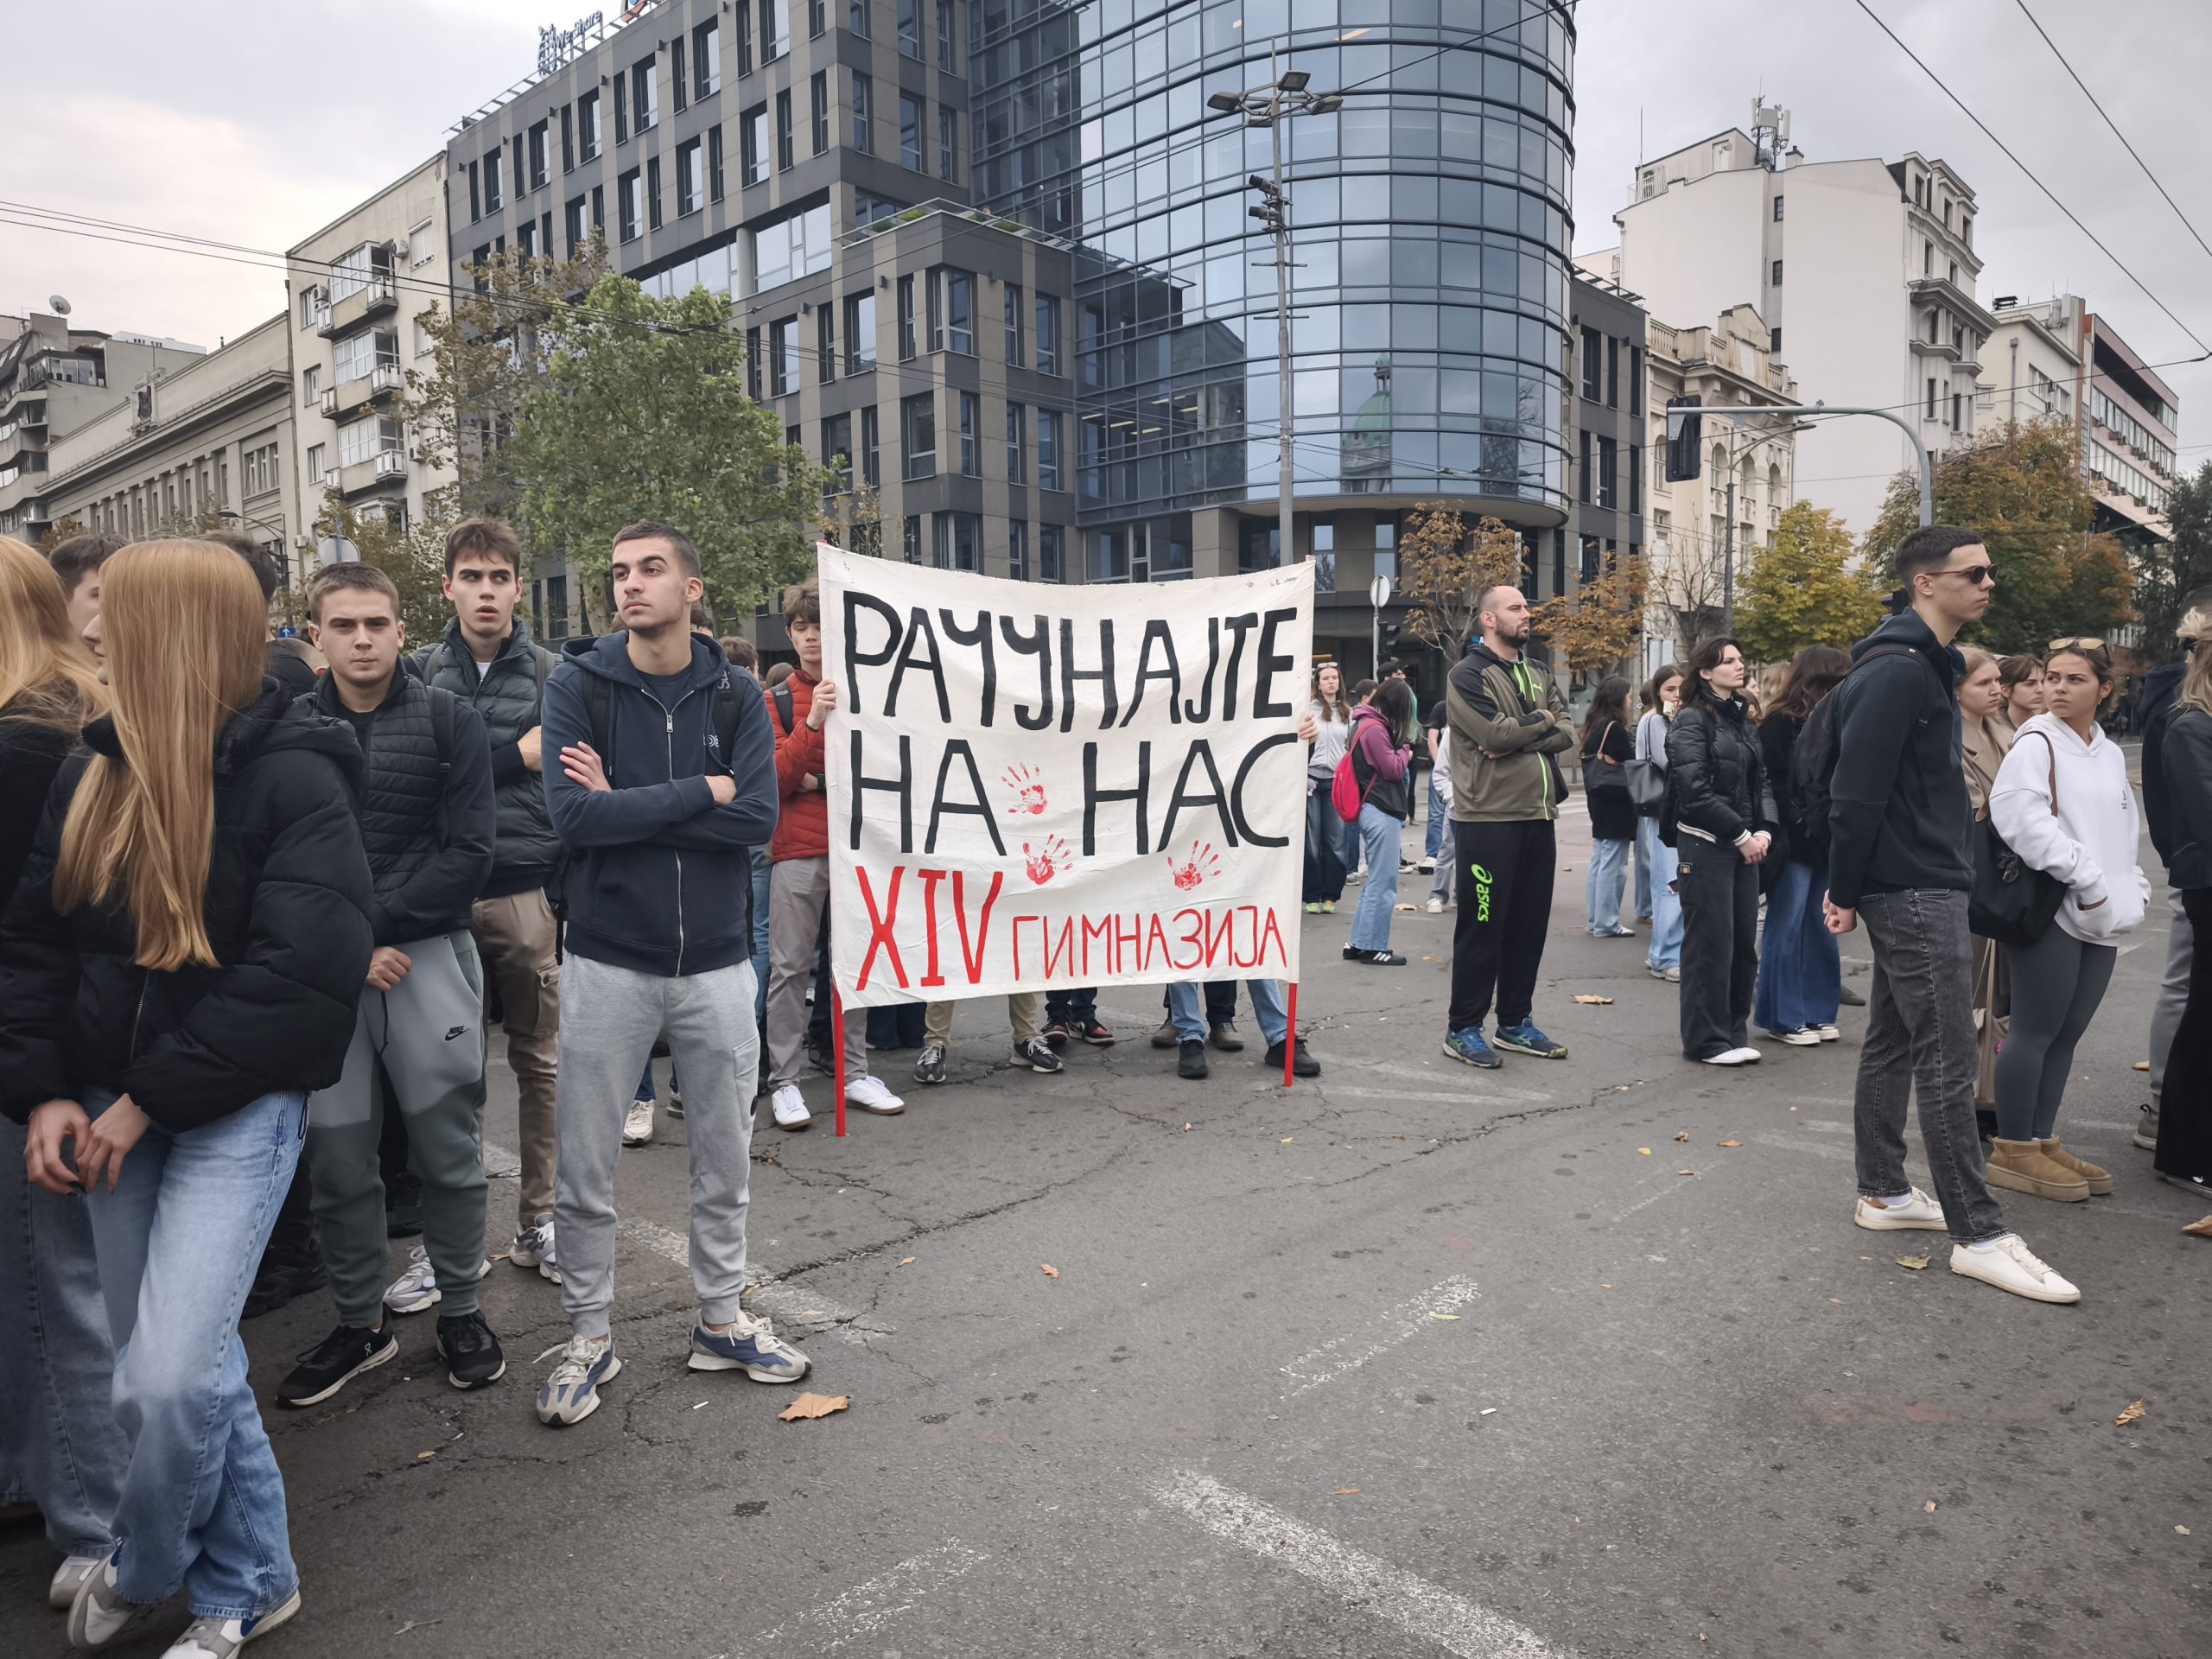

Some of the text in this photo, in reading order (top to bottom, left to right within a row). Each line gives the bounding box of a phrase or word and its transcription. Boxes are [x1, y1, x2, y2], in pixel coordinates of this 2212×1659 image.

[843, 590, 1297, 733] РАЧУНАЈТЕ
[850, 730, 1299, 856] НА НАС
[855, 865, 1287, 991] XIV ГИМНАЗИЈА
[1476, 883, 1490, 923] asics
